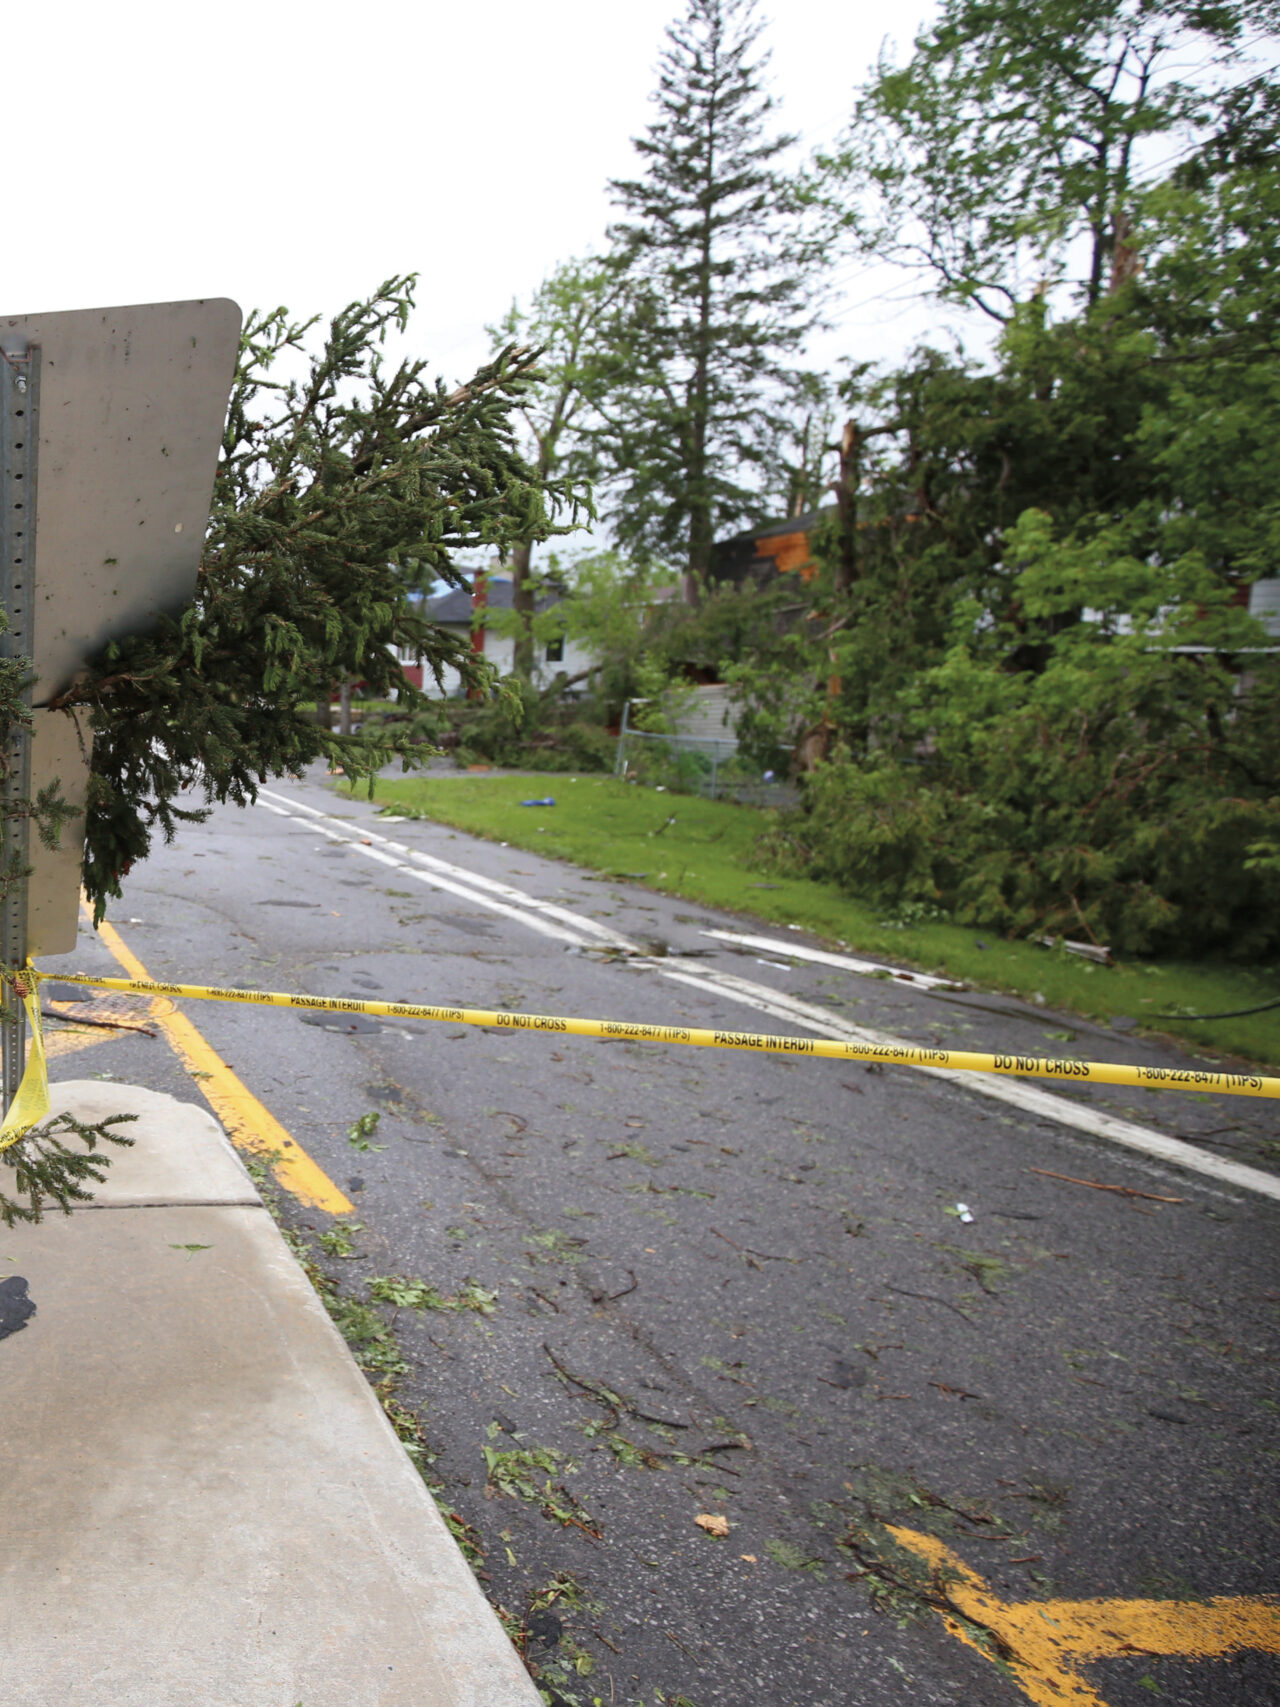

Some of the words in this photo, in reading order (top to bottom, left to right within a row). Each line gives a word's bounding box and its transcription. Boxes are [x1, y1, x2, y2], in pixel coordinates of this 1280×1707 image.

[290, 995, 326, 1008] PASSAGE
[329, 998, 365, 1012] INTERDIT
[386, 1004, 440, 1018] 1-800-222-8477
[441, 1009, 465, 1021] (TIPS)
[497, 1014, 510, 1025] DO
[512, 1015, 531, 1028] NOT
[534, 1016, 567, 1031] CROSS
[600, 1022, 661, 1038] 1-800-222-8477
[664, 1027, 691, 1041] (TIPS)
[714, 1031, 763, 1048] PASSAGE
[765, 1038, 815, 1052] INTERDIT
[844, 1042, 915, 1058] 1-800-222-8477
[919, 1048, 950, 1064] (TIPS)
[993, 1054, 1012, 1070] DO
[1016, 1056, 1041, 1072] NOT
[1045, 1058, 1091, 1076] CROSS
[1136, 1067, 1221, 1085] 1-800-222-8477
[1225, 1073, 1264, 1091] (TIPS)
